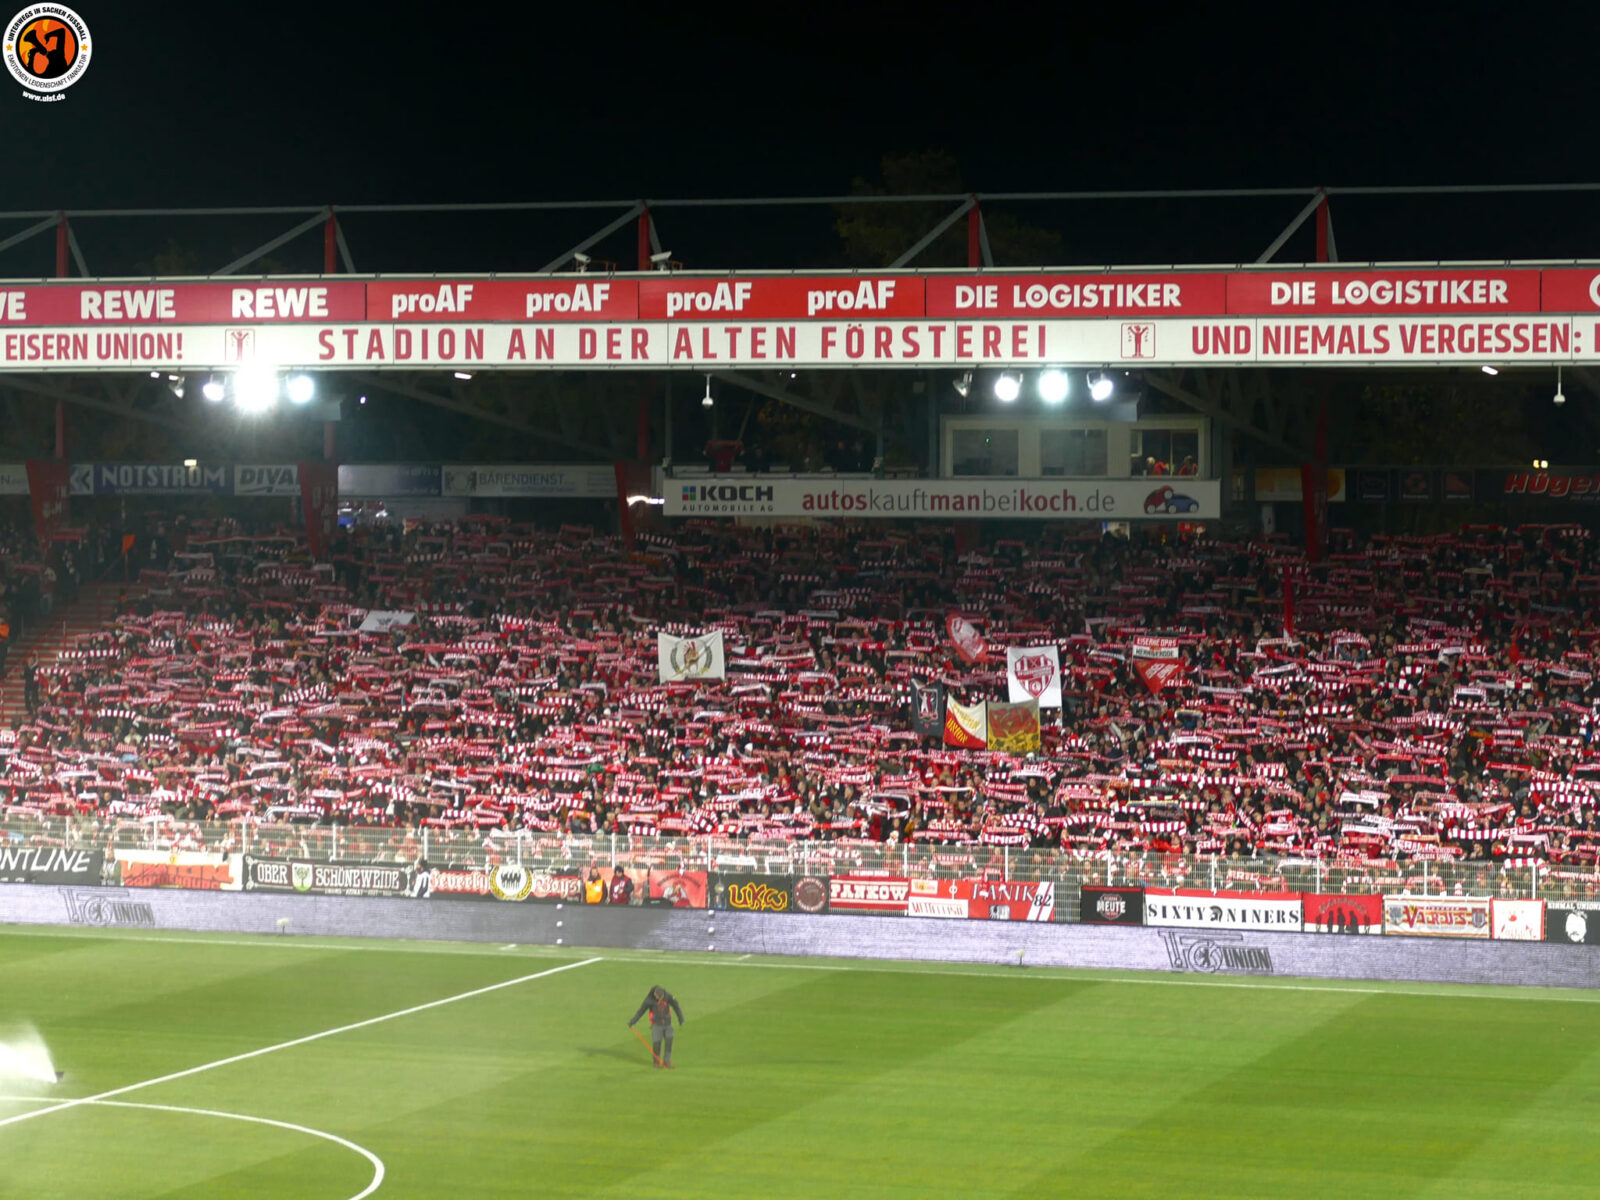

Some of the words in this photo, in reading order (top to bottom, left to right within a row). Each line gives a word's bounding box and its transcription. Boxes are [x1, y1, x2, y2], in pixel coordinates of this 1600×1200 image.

[80, 289, 176, 320] REWE
[231, 287, 329, 319] REWE
[392, 284, 474, 319] proAF
[526, 283, 611, 318] proAF
[666, 282, 752, 318] proAF
[807, 280, 896, 317] proAF
[955, 285, 998, 309] DIE
[1013, 283, 1182, 309] LOGISTIKER
[1271, 281, 1316, 306] DIE
[1331, 279, 1508, 305] LOGISTIKER
[5, 334, 89, 361] EISERN
[96, 332, 183, 361] UNION!
[318, 328, 484, 361] STADION
[506, 328, 555, 361] AN
[578, 328, 650, 361] DER
[673, 326, 797, 360] ALTEN
[820, 323, 1046, 359] FÖRSTEREI
[1191, 325, 1251, 356] UND
[1262, 324, 1390, 356] NIEMALS
[1399, 322, 1582, 355] VERGESSEN:
[239, 466, 294, 486] DIVA
[700, 485, 774, 501] KOCH
[801, 487, 1116, 513] autoskauftmanbeikoch.de
[681, 503, 754, 513] AUTOMOBILE
[760, 504, 774, 513] AG
[0, 847, 91, 873] NTLINE
[256, 863, 288, 885] OBER
[315, 866, 400, 890] SCHÖNEWEIDE
[830, 883, 909, 900] PANKOW
[1096, 899, 1126, 914] MEUTE
[1147, 903, 1206, 922] SIXTY
[1226, 907, 1300, 924] NINERS
